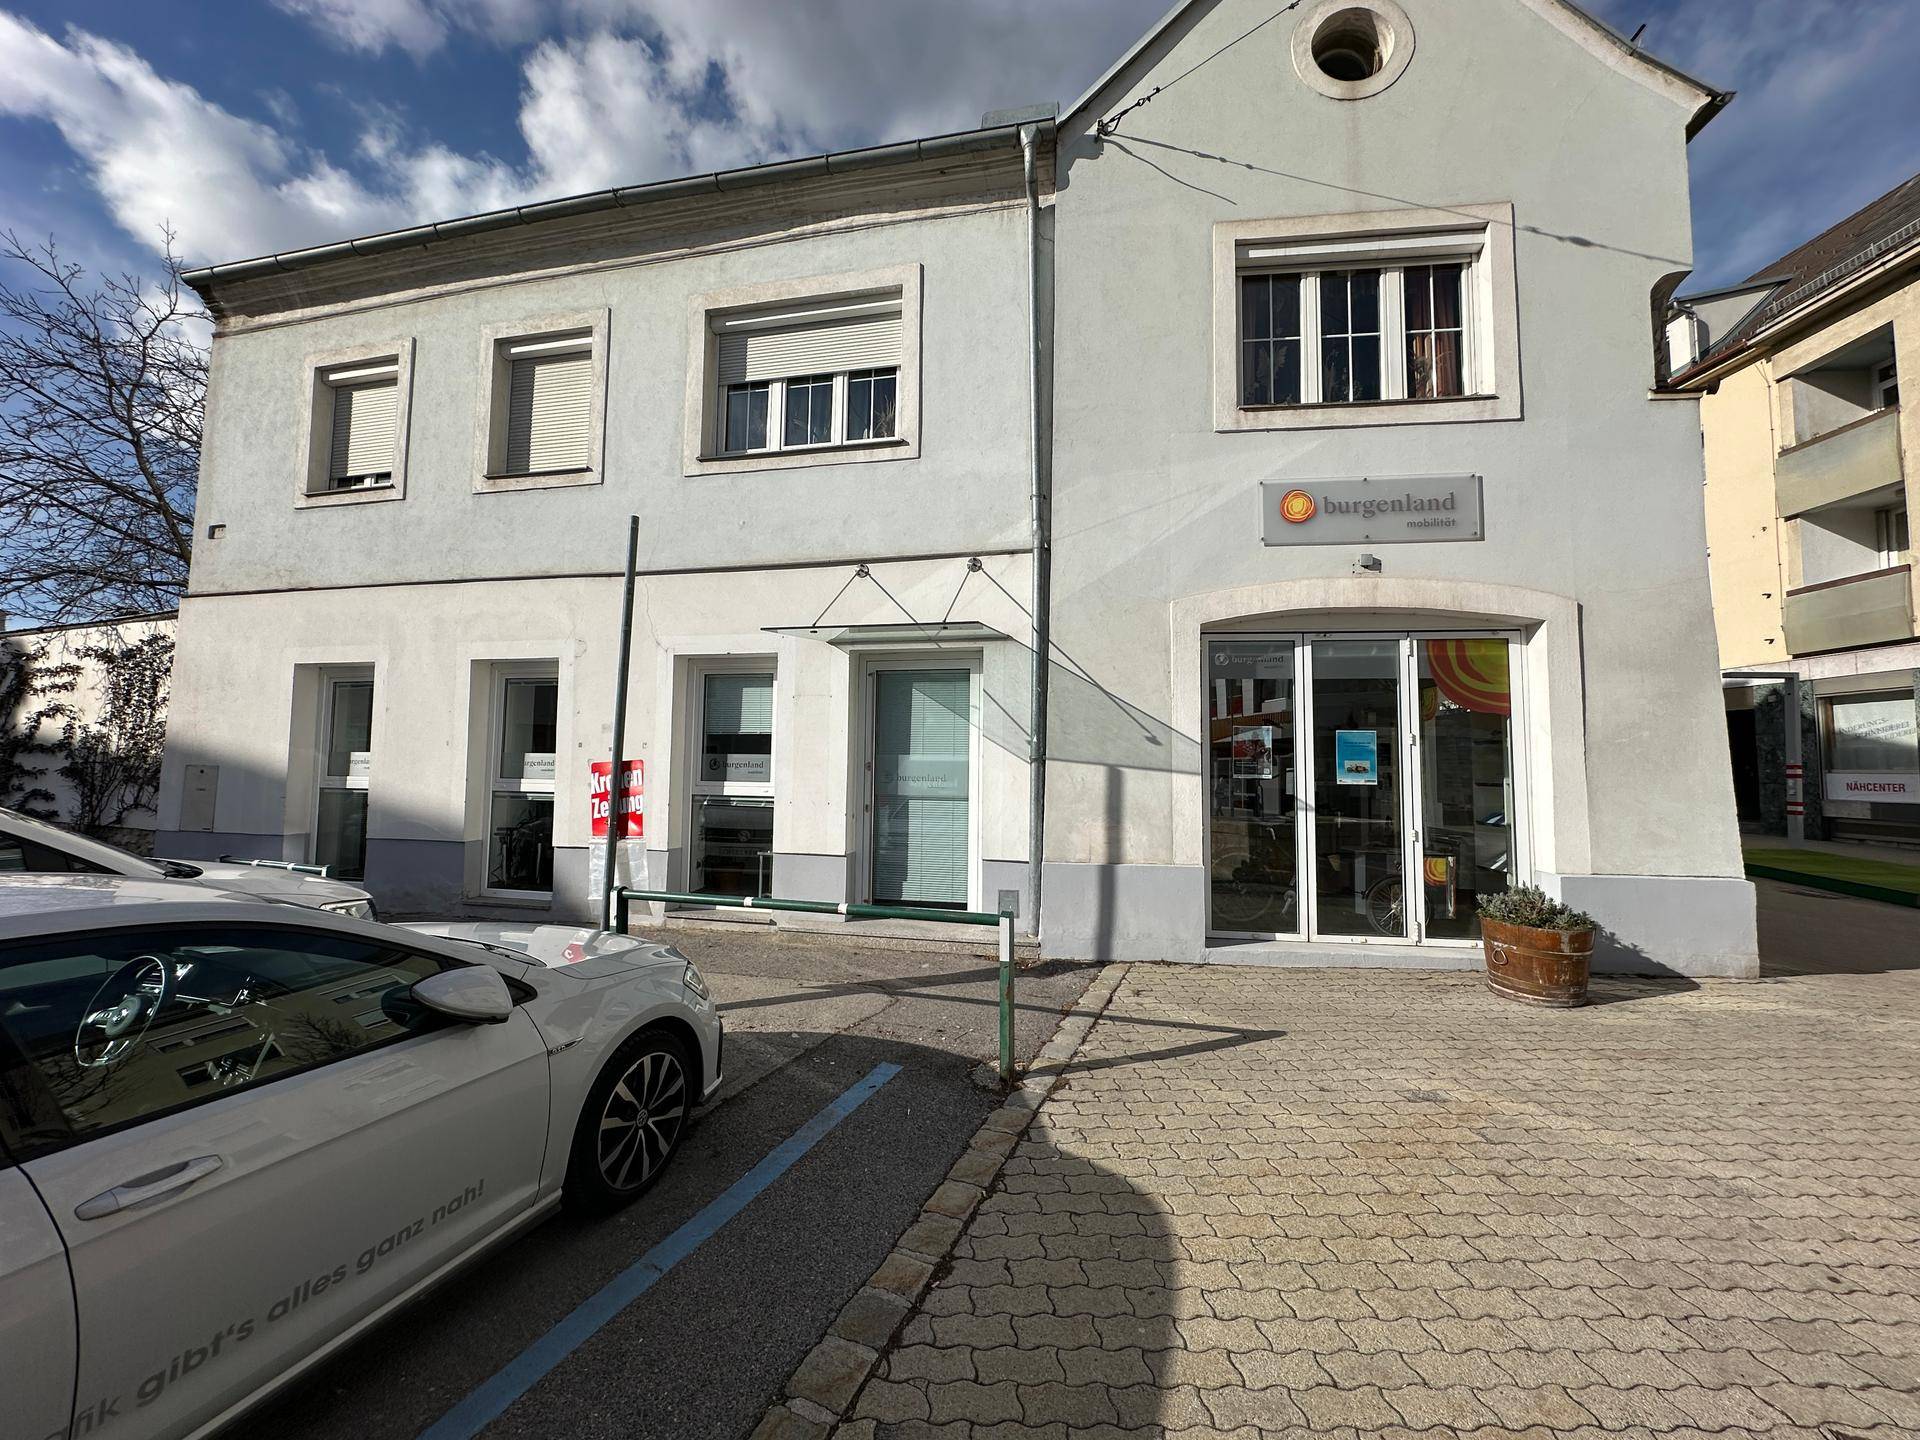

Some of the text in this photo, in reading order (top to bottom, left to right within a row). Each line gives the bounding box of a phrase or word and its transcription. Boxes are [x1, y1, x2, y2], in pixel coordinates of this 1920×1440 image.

[1323, 491, 1456, 518] burgenland
[1407, 518, 1456, 529] mobilität
[591, 768, 643, 794] Kroen
[1846, 780, 1906, 793] NÄHCENTER
[591, 795, 643, 819] Zeung
[267, 1263, 347, 1322] alles
[356, 1217, 425, 1275] ganz
[432, 1178, 484, 1226] nah!
